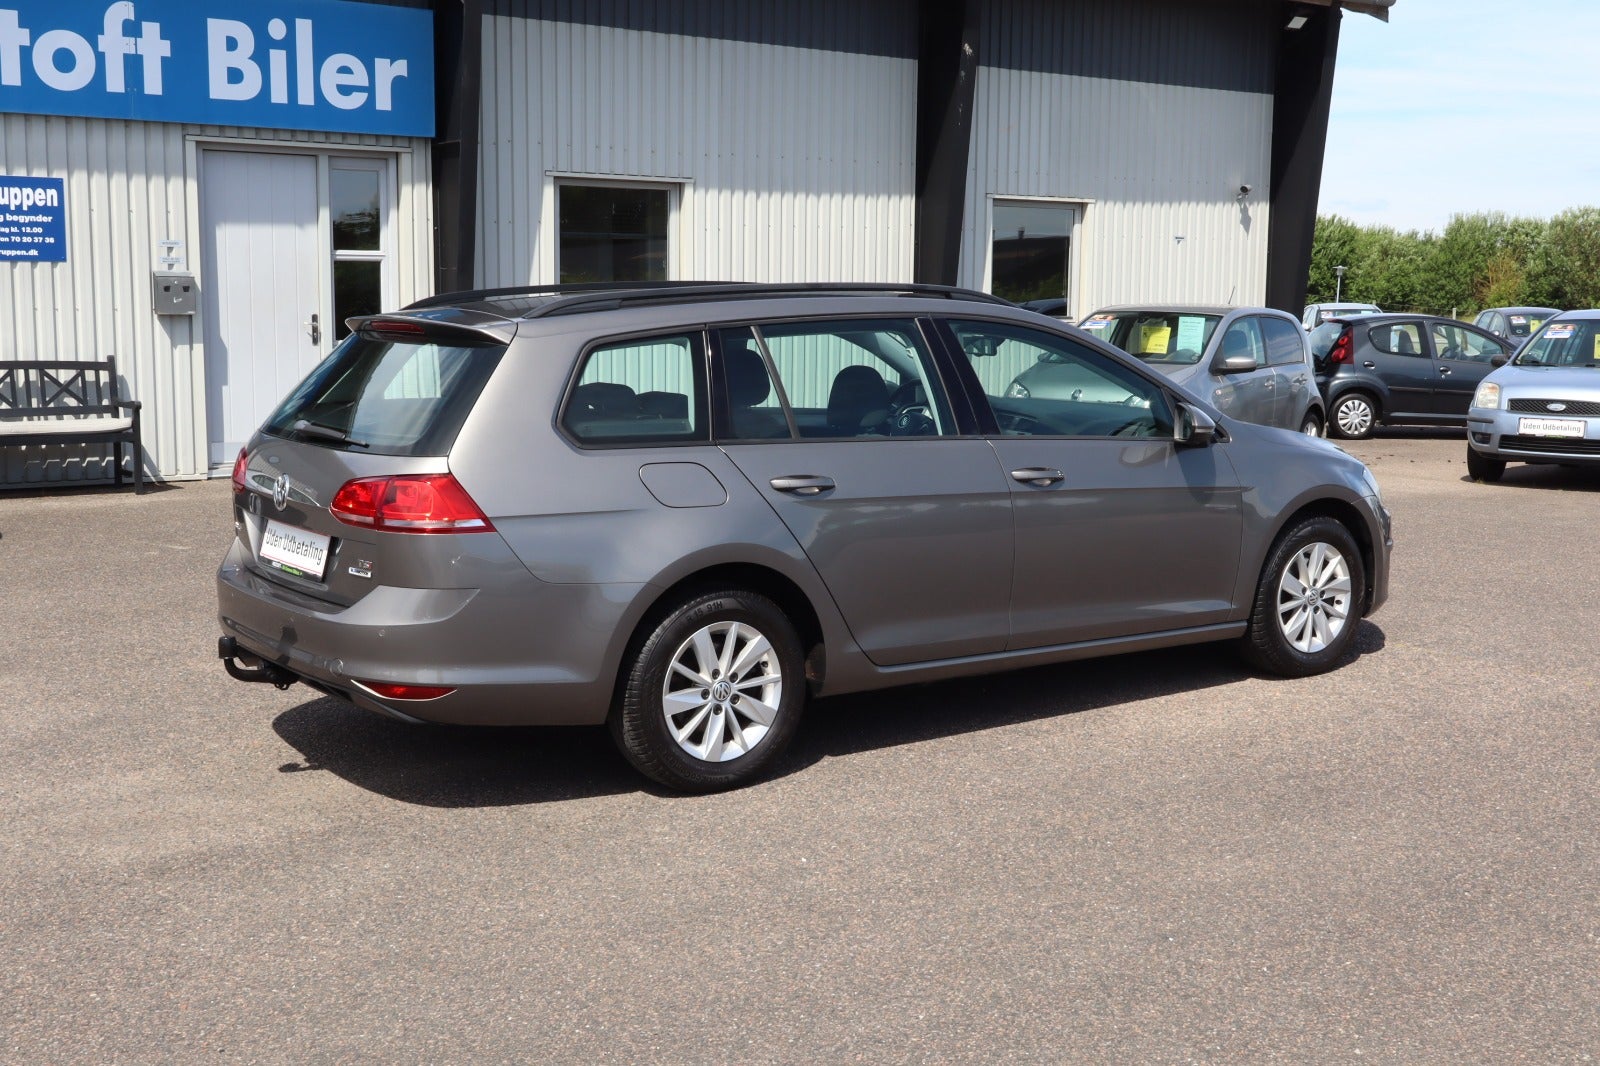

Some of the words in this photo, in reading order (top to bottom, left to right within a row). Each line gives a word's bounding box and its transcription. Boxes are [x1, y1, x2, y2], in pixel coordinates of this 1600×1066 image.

[206, 17, 408, 111] Biler
[6, 213, 53, 223] begynder
[265, 527, 283, 548] Uden
[282, 532, 324, 566] Udbetaling
